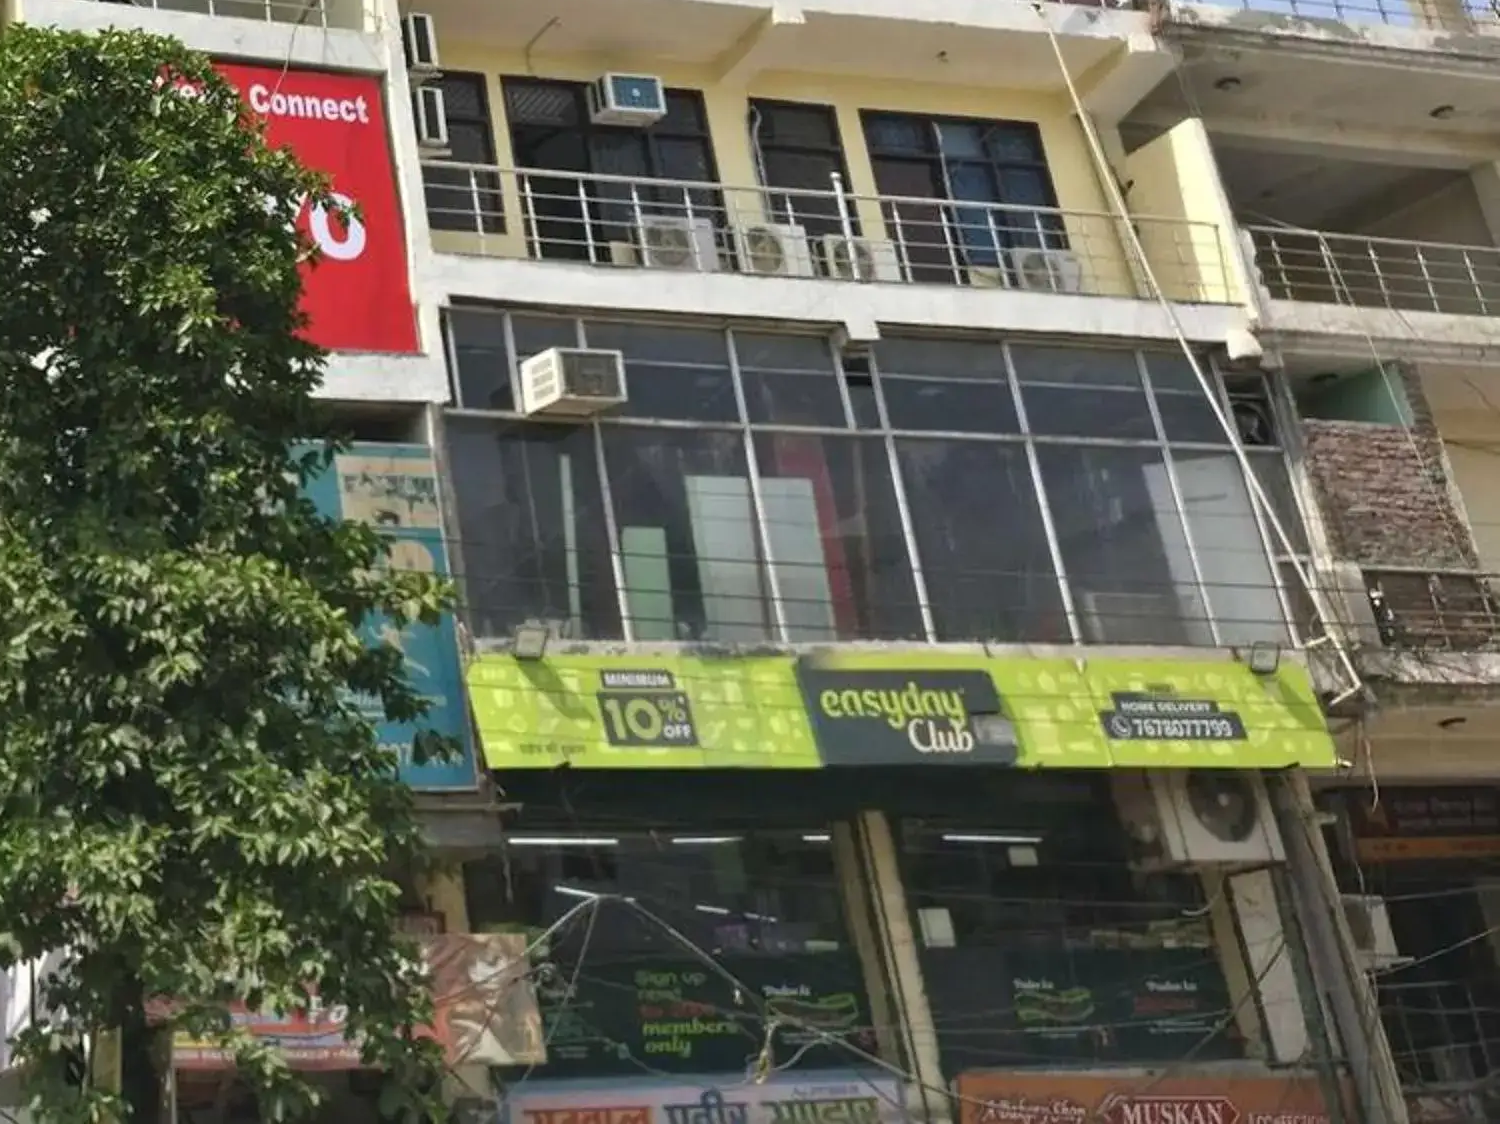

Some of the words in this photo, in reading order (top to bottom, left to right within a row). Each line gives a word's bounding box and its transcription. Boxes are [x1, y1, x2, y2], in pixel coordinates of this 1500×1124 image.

[250, 84, 369, 123] Connect
[820, 681, 966, 728] easyday
[1120, 701, 1154, 712] HOME
[663, 724, 692, 739] OFF
[907, 718, 974, 752] Club
[1122, 1103, 1224, 1124] MUSKAN
